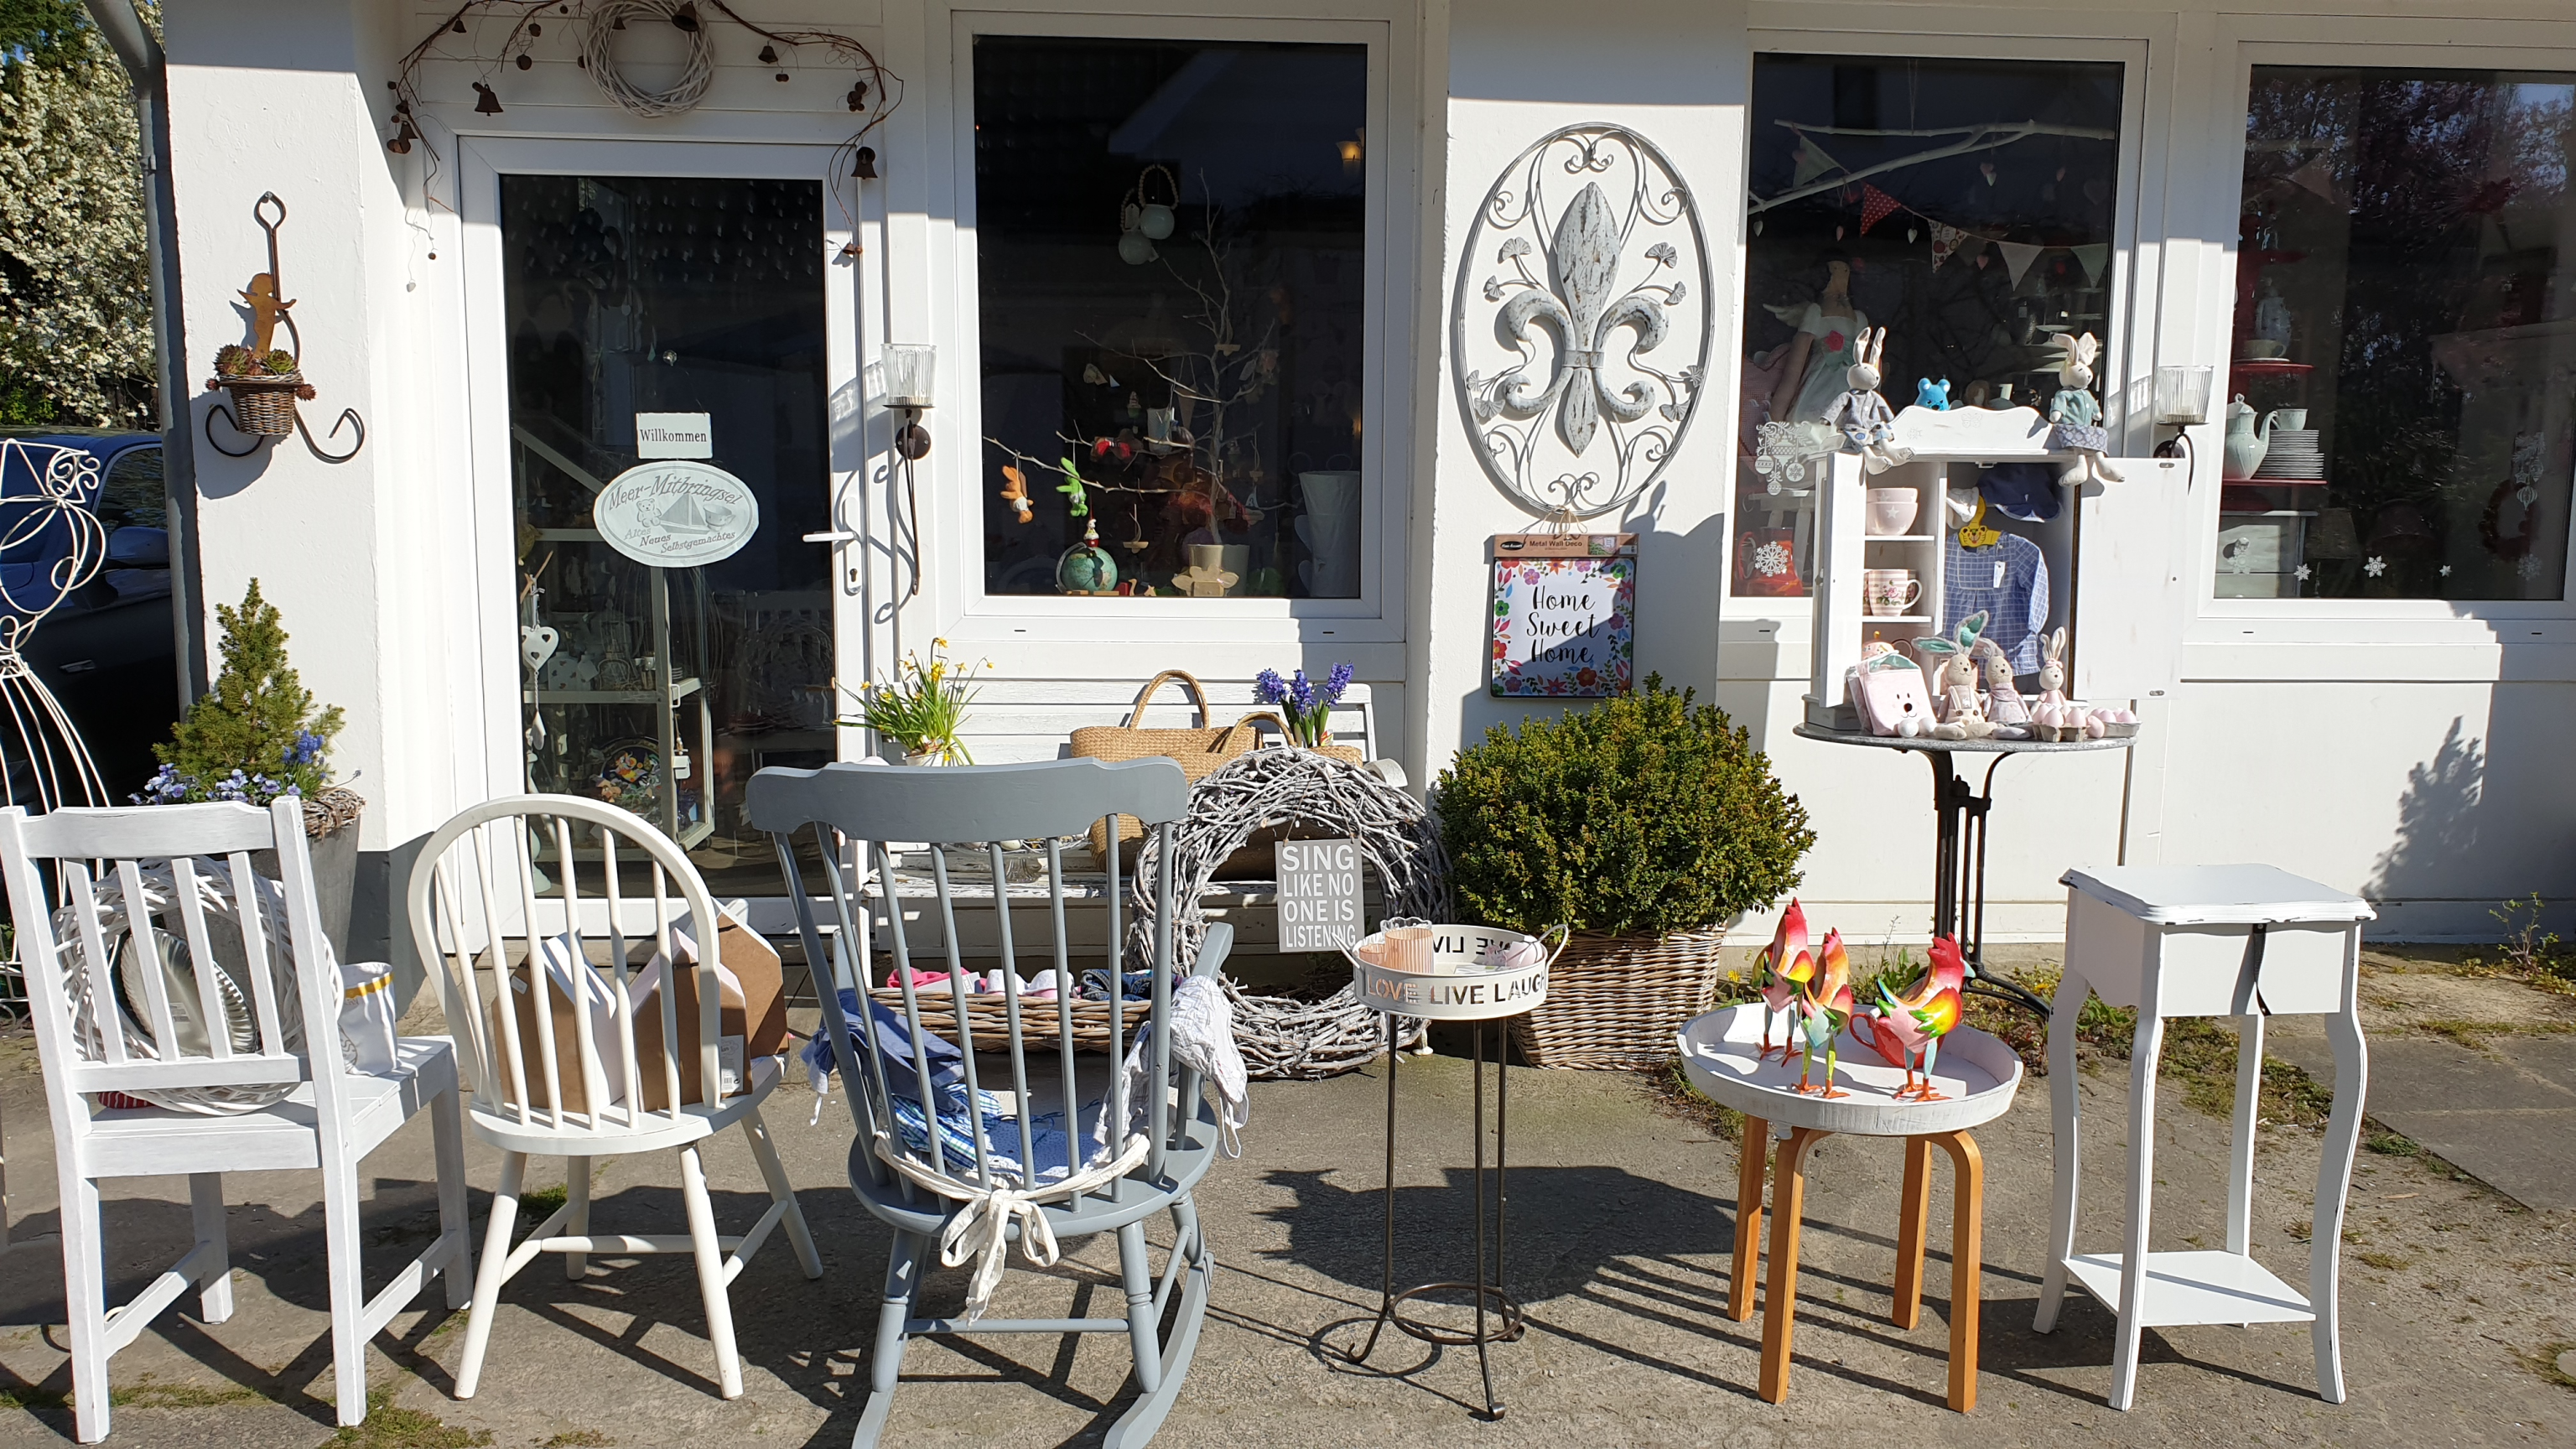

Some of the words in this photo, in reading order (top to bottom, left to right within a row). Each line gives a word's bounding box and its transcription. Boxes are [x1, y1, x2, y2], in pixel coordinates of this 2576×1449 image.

[640, 428, 707, 443] Willkommen
[609, 473, 743, 511] Meer-Mitbringsel
[623, 527, 652, 541] Altes
[639, 534, 672, 547] Neues
[660, 531, 736, 554] Selbstgemachtes
[1532, 585, 1596, 611] Home
[1526, 612, 1600, 638] Sweet
[1531, 639, 1593, 664] Home
[1282, 844, 1354, 871] SING
[1283, 873, 1323, 897] LIKE
[1328, 873, 1354, 896] NO
[1284, 900, 1328, 922] ONE
[1334, 899, 1354, 922] IS
[1285, 924, 1356, 948] LISTENING
[1367, 974, 1420, 1005] LOVE
[1429, 984, 1484, 1005] LIVE
